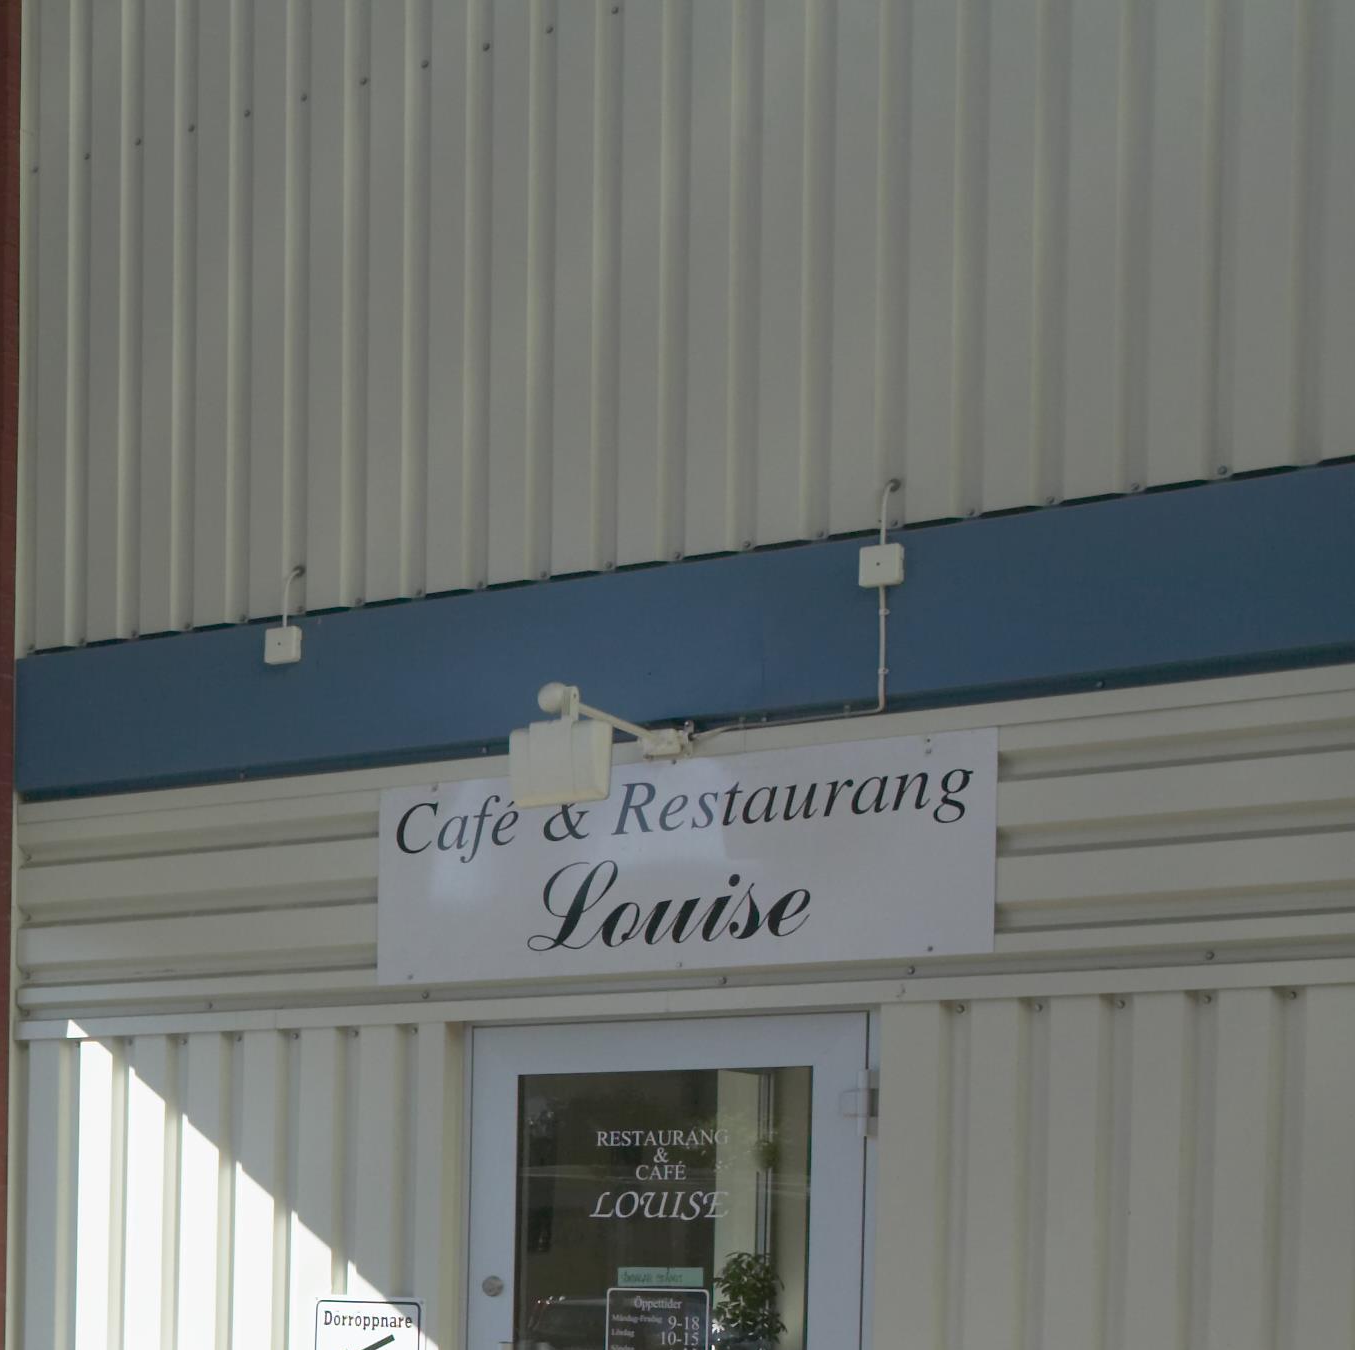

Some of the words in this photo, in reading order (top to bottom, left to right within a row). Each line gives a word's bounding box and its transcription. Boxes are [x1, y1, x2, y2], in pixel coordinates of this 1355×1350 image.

[396, 795, 516, 864] Café
[543, 804, 590, 843] &
[611, 766, 975, 836] Restaurang
[527, 860, 811, 952] Louise
[596, 1129, 728, 1147] RESTAURANG
[653, 1147, 669, 1163] &
[636, 1161, 686, 1180] CAFÉ
[589, 1191, 729, 1220] LOUISE
[634, 1296, 683, 1311] Öppettider
[324, 1310, 413, 1331] Dörröppnare
